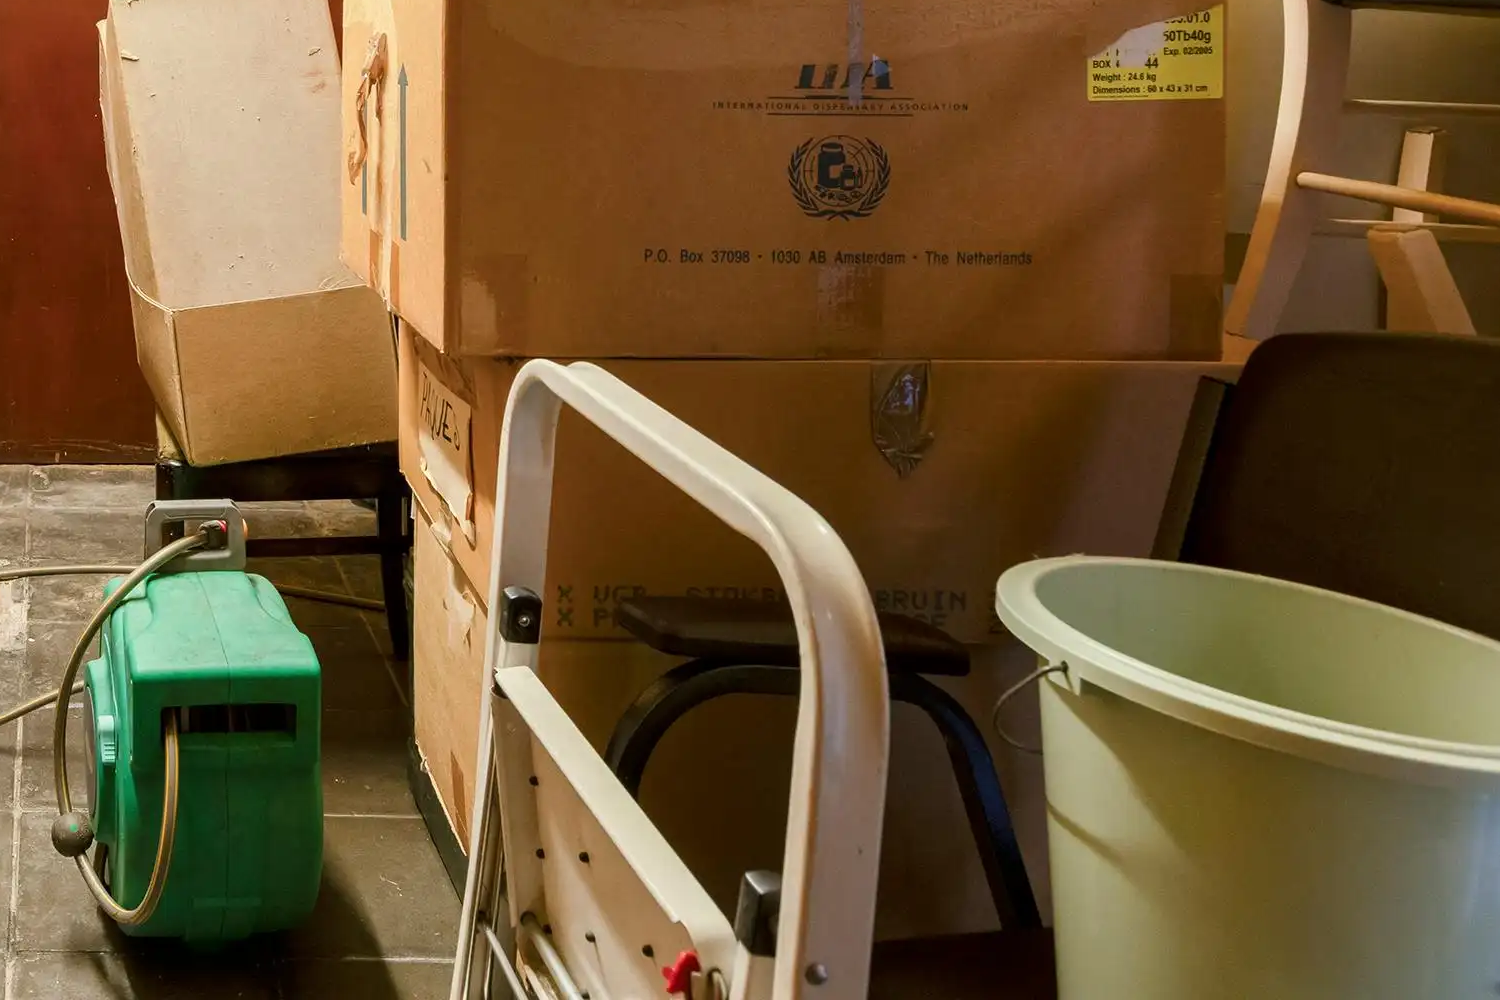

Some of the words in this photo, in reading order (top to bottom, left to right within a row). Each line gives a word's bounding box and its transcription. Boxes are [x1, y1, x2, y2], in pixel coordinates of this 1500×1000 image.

[1093, 74, 1121, 83] Weight
[1147, 73, 1156, 82] kg
[1093, 86, 1140, 94] Dimensions
[712, 101, 807, 111] INTERNATIONAL
[890, 103, 969, 112] ASSOCIATION
[643, 250, 672, 263] P.O.
[680, 250, 703, 263] Box
[711, 250, 751, 264] 37098
[771, 250, 800, 264] 1030
[809, 251, 826, 264] AB
[834, 251, 905, 265] Amsterdam
[925, 251, 949, 265] The
[956, 251, 1032, 265] Netherlands
